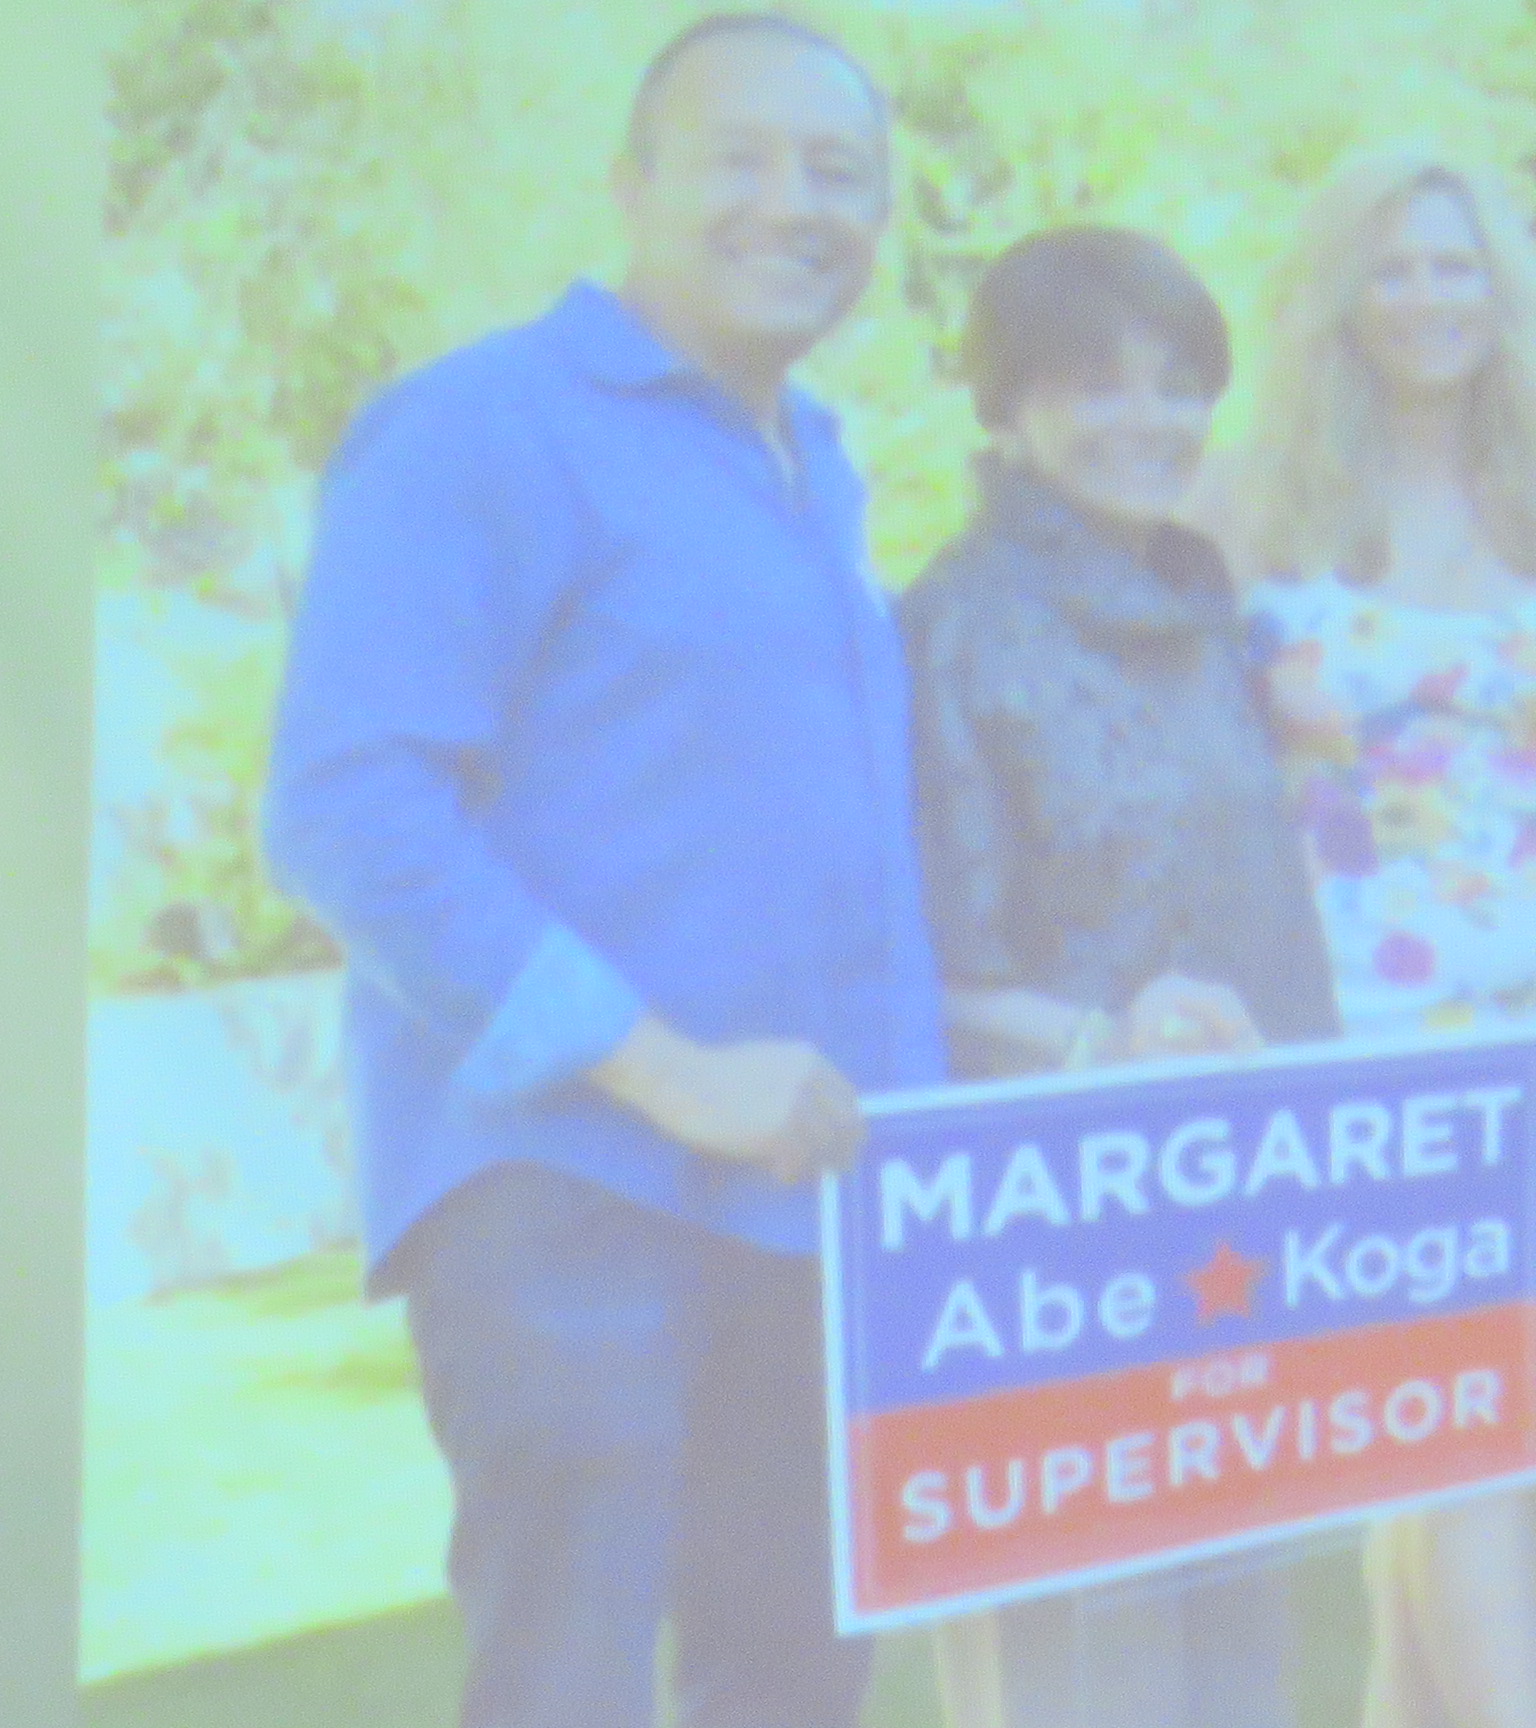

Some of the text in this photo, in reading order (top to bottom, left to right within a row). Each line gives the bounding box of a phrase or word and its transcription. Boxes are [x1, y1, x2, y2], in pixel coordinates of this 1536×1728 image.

[879, 1086, 1522, 1251] MARGARET
[922, 1215, 1512, 1373] Abe Koga
[901, 1368, 1504, 1544] SUPERVISOR
[1170, 1353, 1271, 1400] FOR
